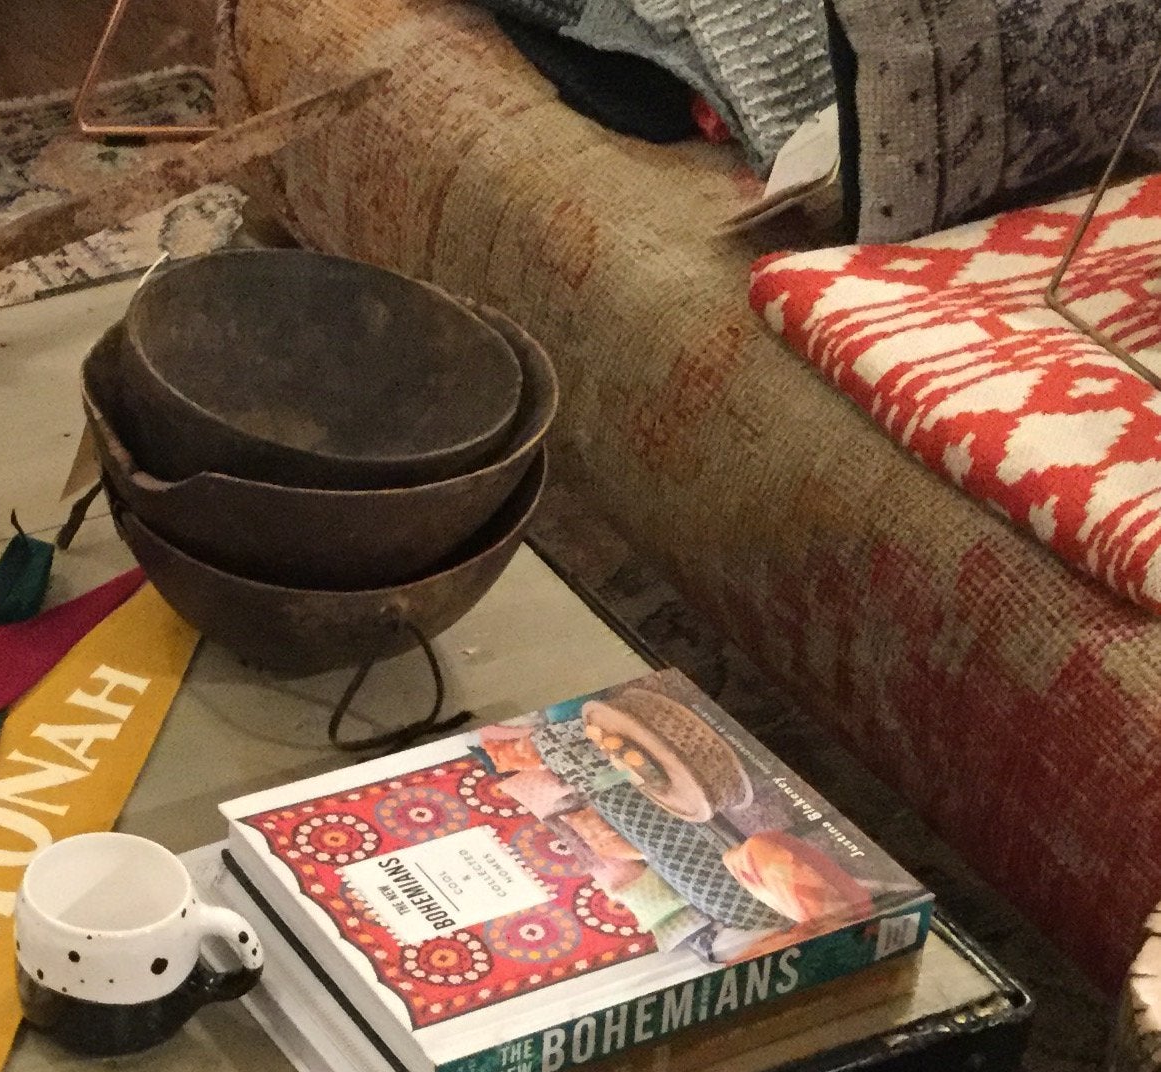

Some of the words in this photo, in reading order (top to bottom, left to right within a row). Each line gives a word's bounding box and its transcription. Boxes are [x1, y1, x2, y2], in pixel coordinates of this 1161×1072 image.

[771, 776, 823, 822] Blakeney
[439, 870, 464, 896] COOL
[458, 848, 507, 898] COLLECTED
[482, 853, 514, 884] HOMES
[377, 885, 399, 902] NEW
[377, 857, 457, 932] BOHEMIANS
[392, 900, 412, 916] THE
[500, 1038, 534, 1067] THE
